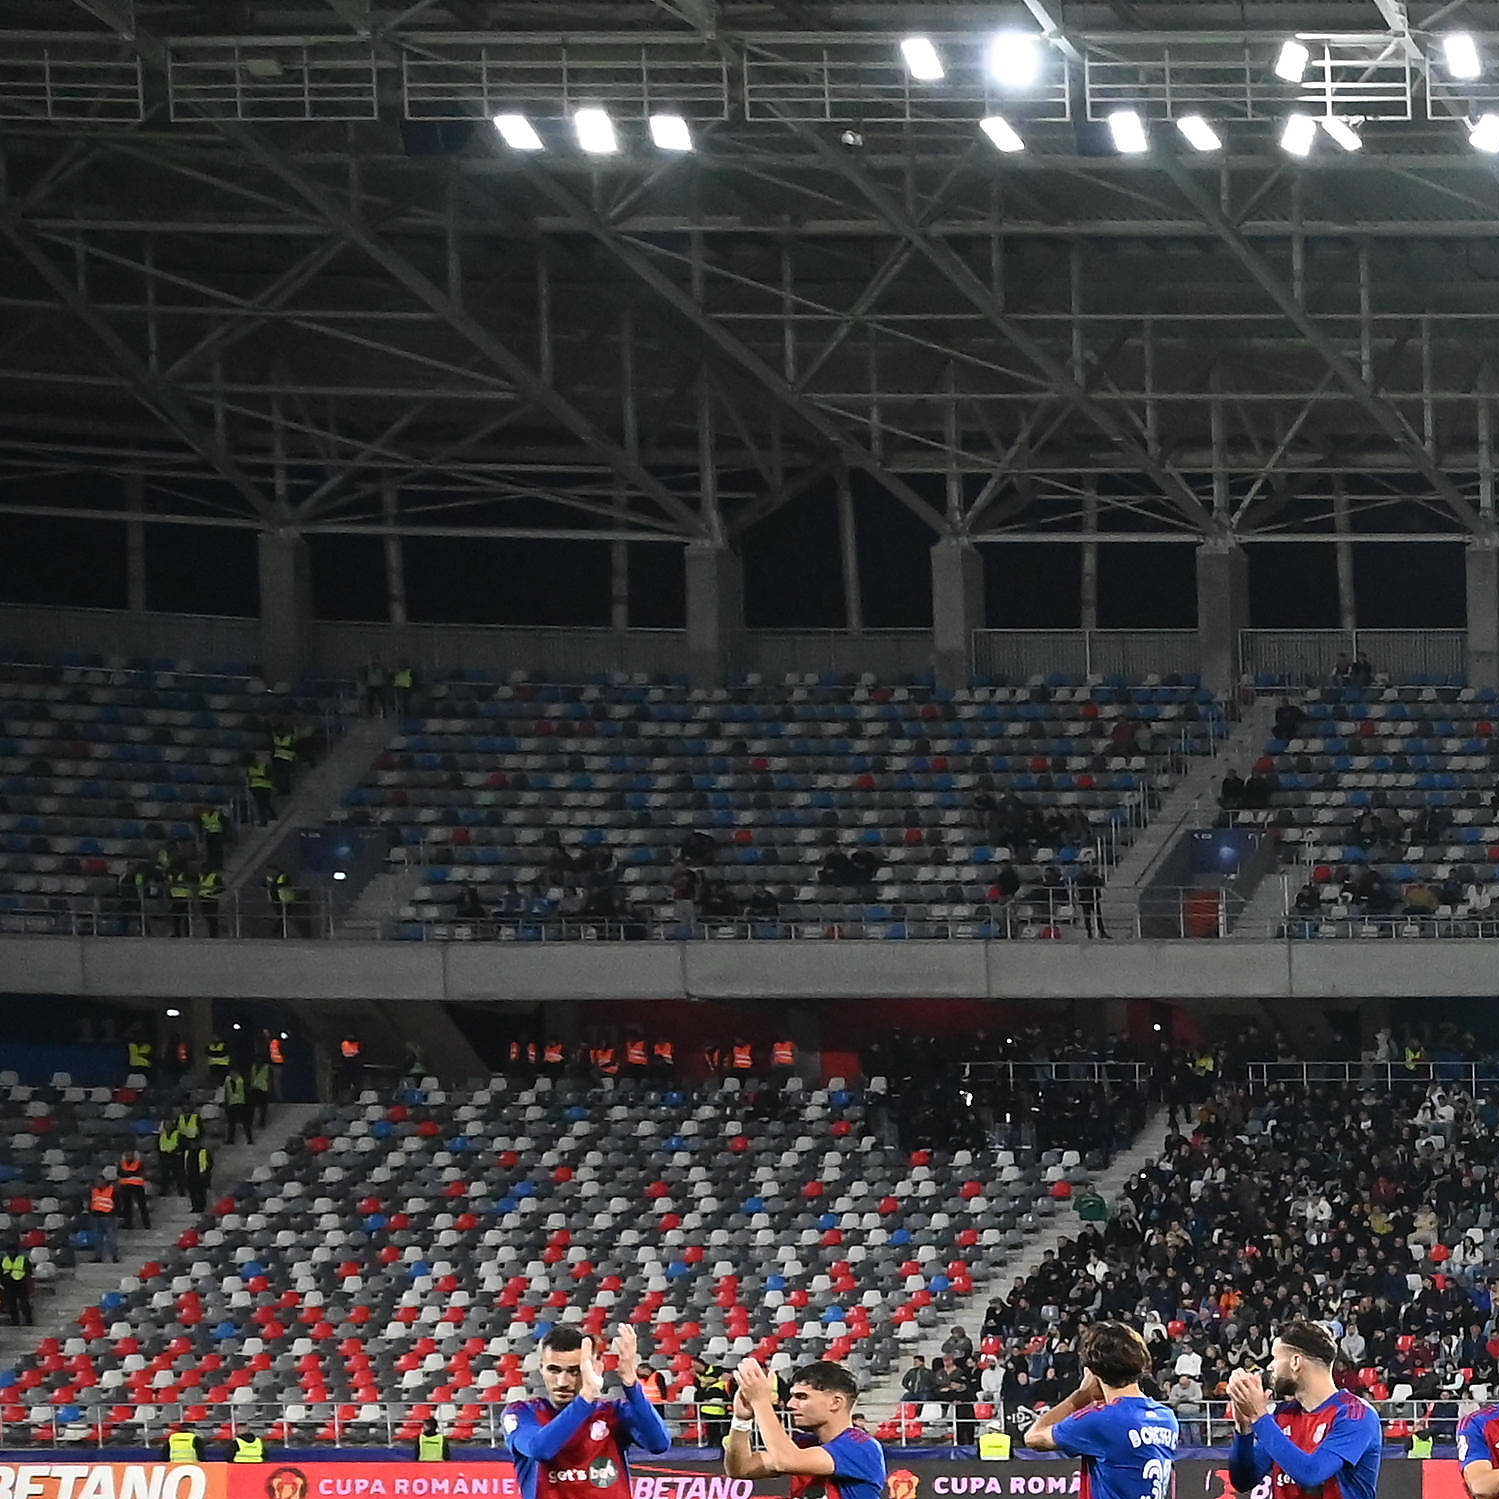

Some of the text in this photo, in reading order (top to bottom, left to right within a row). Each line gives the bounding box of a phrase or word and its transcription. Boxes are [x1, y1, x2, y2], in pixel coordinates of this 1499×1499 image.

[318, 1473, 522, 1495] CUPA ROMÂNIE
[934, 1477, 1002, 1494] CUPA
